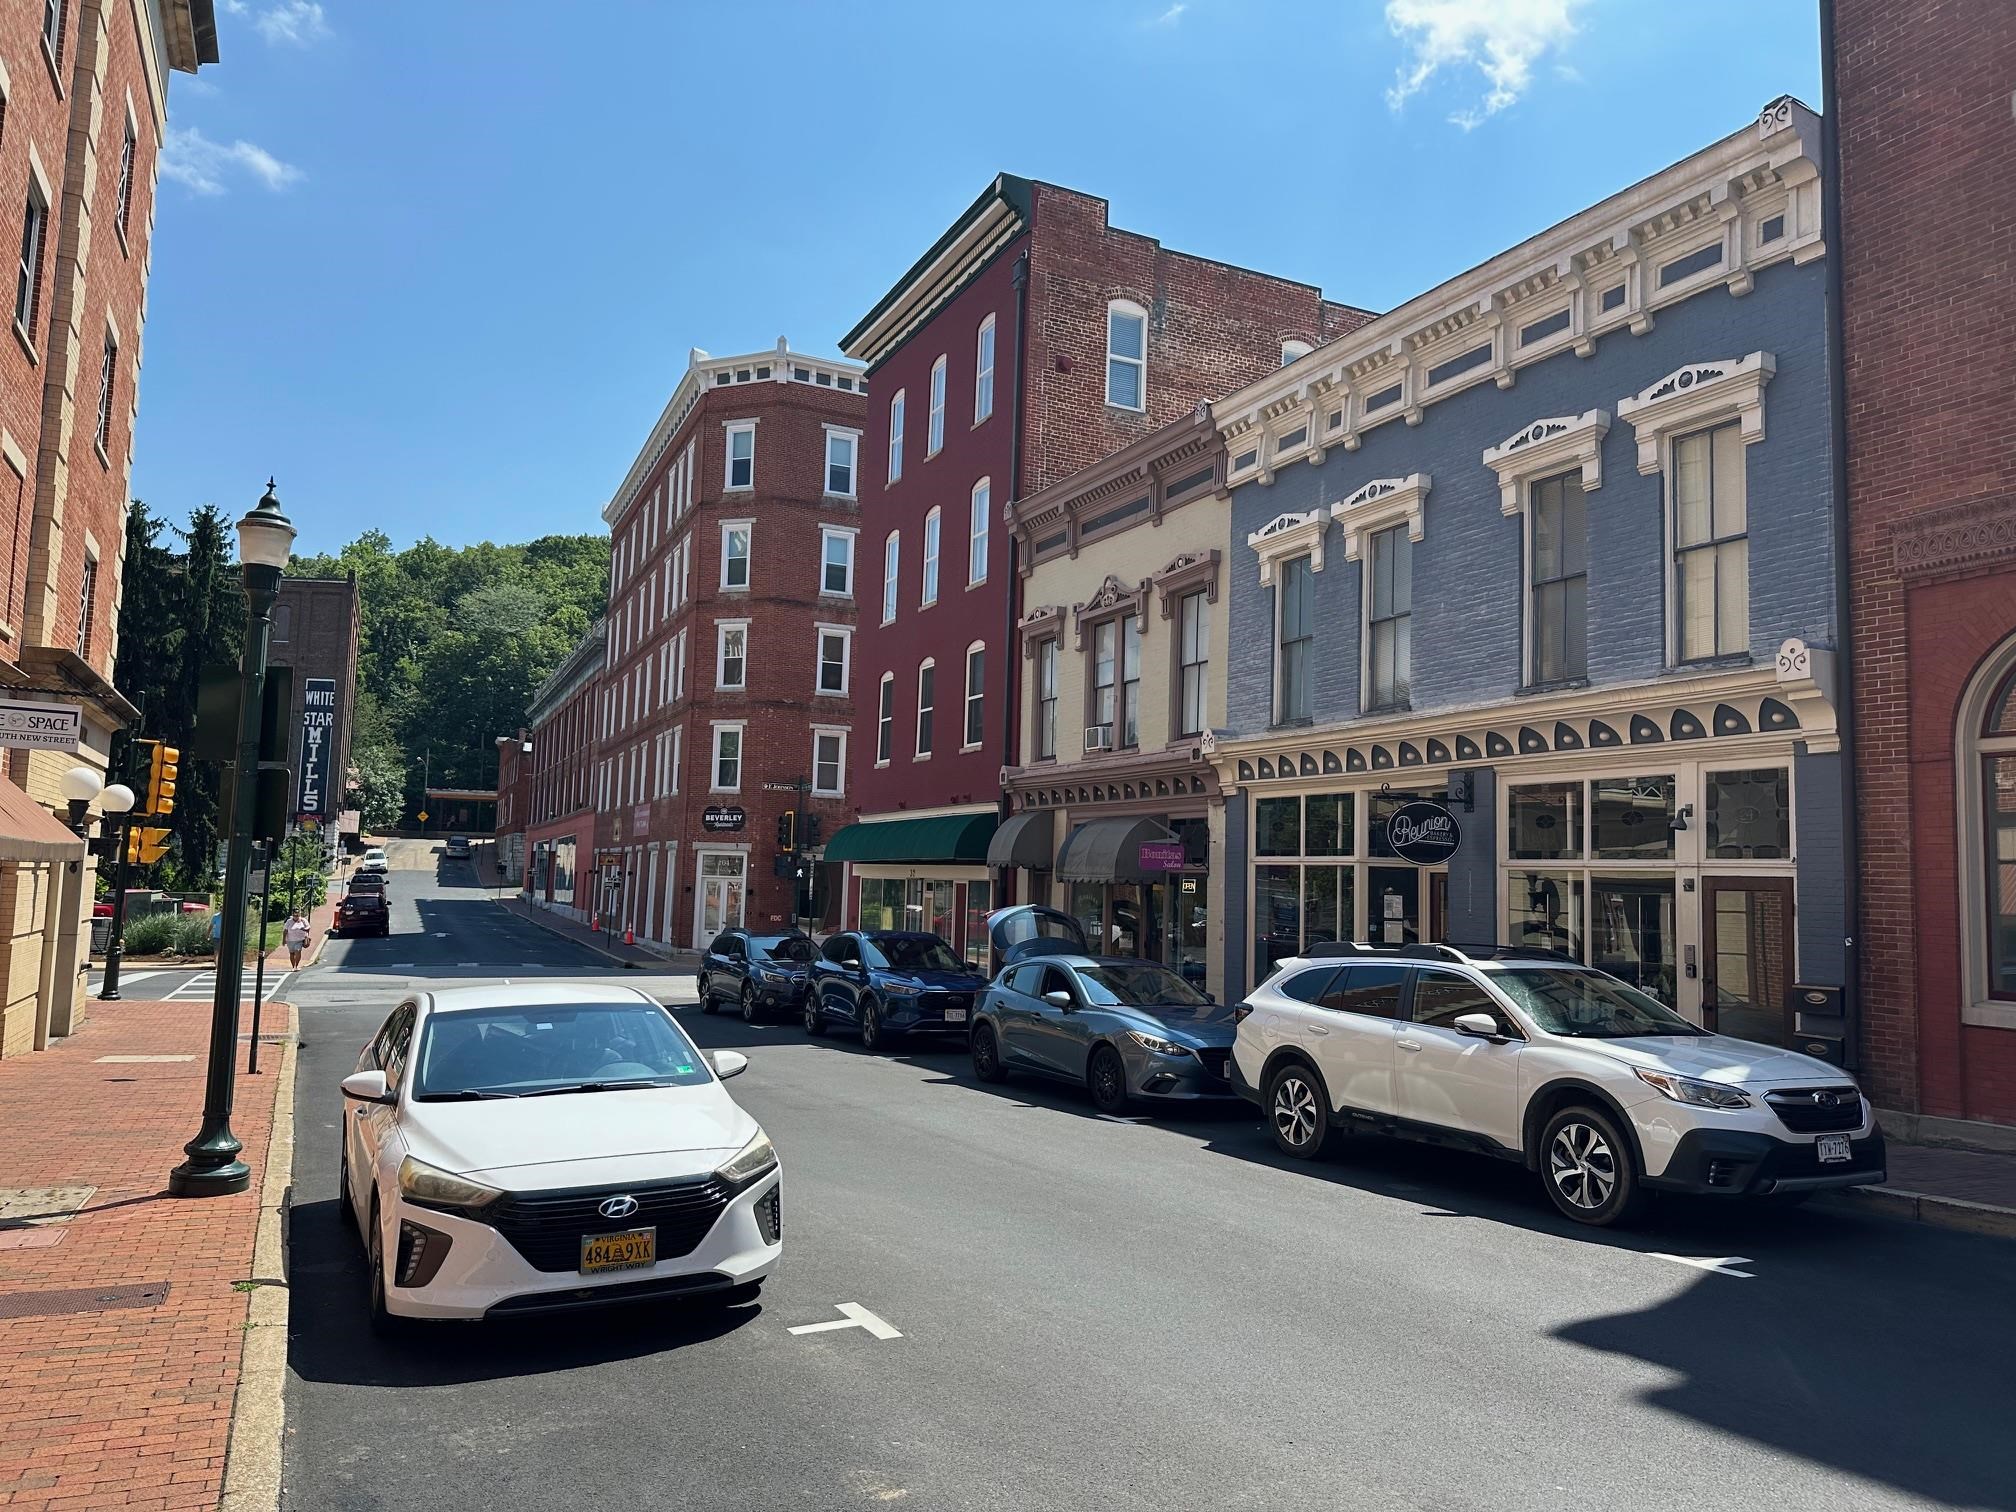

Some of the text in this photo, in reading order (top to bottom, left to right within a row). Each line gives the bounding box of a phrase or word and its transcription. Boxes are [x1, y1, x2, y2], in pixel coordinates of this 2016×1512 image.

[305, 690, 335, 706] WHITE
[27, 716, 70, 731] SPACE
[303, 711, 334, 726] STAR
[20, 733, 42, 742] NEW
[43, 735, 77, 745] STREET
[302, 726, 322, 812] MILLS
[705, 814, 743, 822] BEVERLEY
[1391, 815, 1452, 847] Reunion
[1162, 860, 1182, 868] Salon
[1183, 882, 1196, 891] OPEN
[770, 914, 782, 922] FDC
[601, 1233, 636, 1243] VIRGINIA
[585, 1244, 611, 1264] 484
[590, 1264, 623, 1274] WRIGHT
